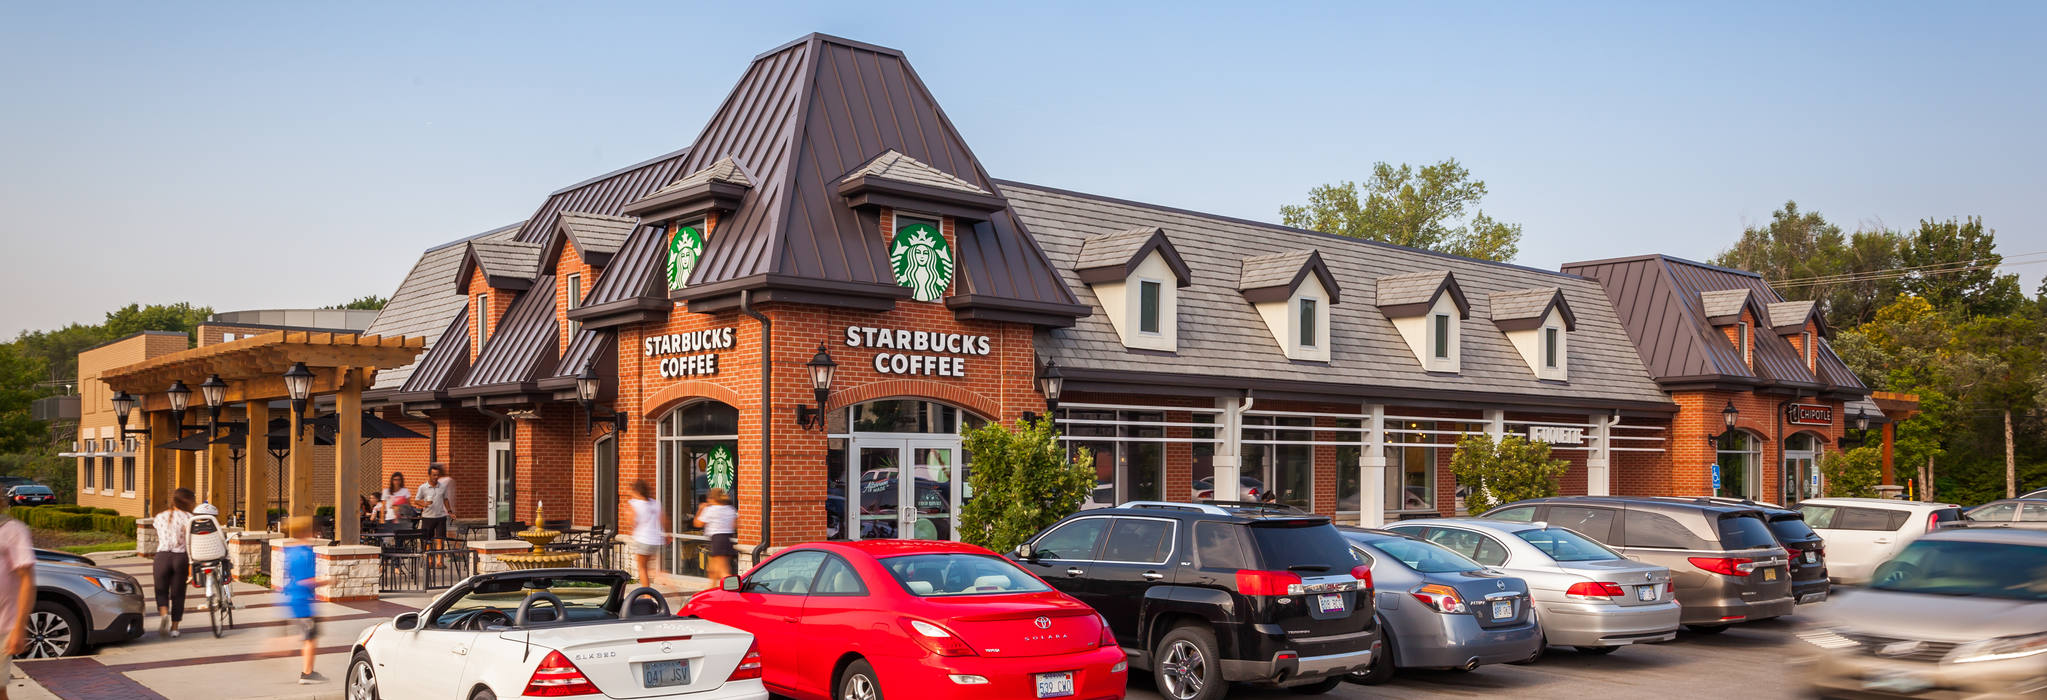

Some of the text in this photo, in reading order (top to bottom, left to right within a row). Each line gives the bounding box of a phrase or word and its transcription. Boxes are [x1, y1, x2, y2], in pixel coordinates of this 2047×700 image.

[644, 327, 733, 356] STARBUCKS
[846, 326, 990, 355] STARBUCKS
[660, 353, 716, 377] COFFEE
[875, 353, 965, 377] COFFEE
[1800, 408, 1831, 420] CHIPOTLE
[647, 667, 687, 684] 041 JSV
[1039, 681, 1053, 695] 539
